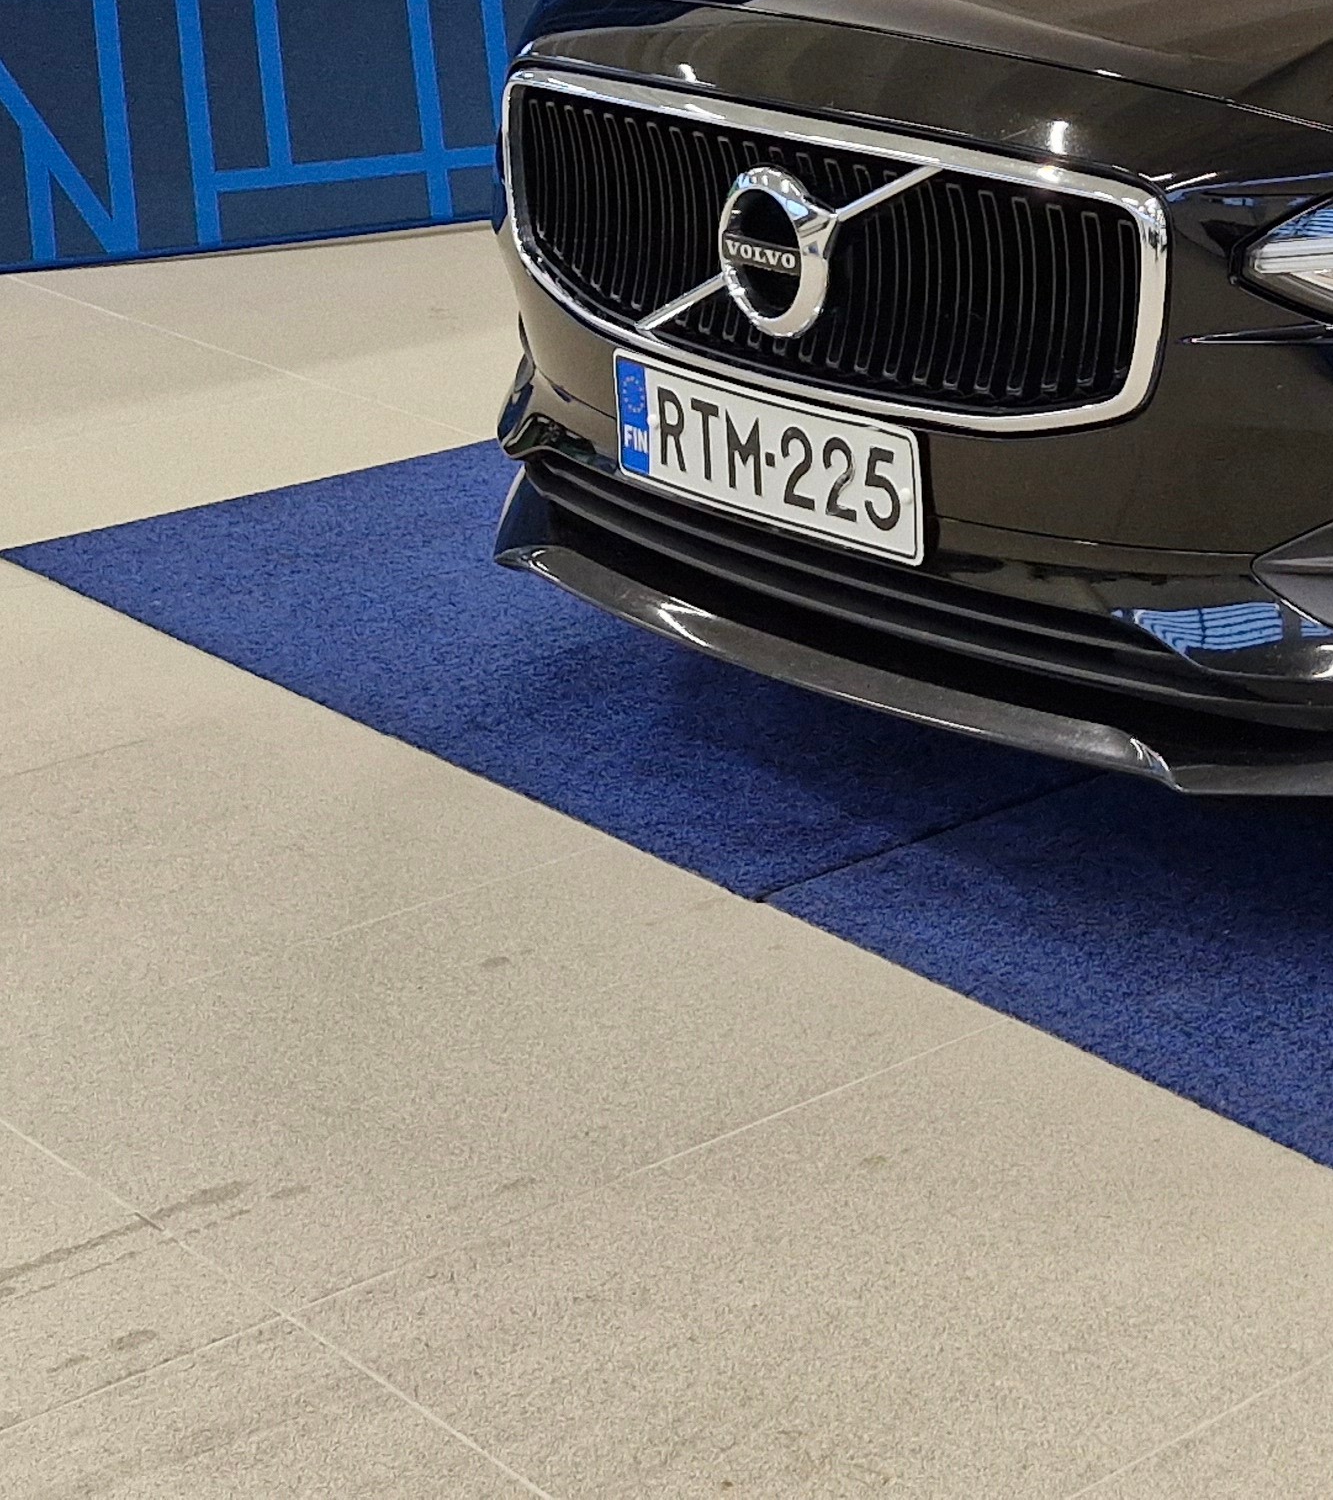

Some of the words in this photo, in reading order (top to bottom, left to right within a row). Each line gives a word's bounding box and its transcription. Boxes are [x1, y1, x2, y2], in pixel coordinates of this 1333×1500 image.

[725, 239, 796, 269] VOLVO
[623, 424, 648, 454] FIN
[657, 386, 901, 531] RTM-225
